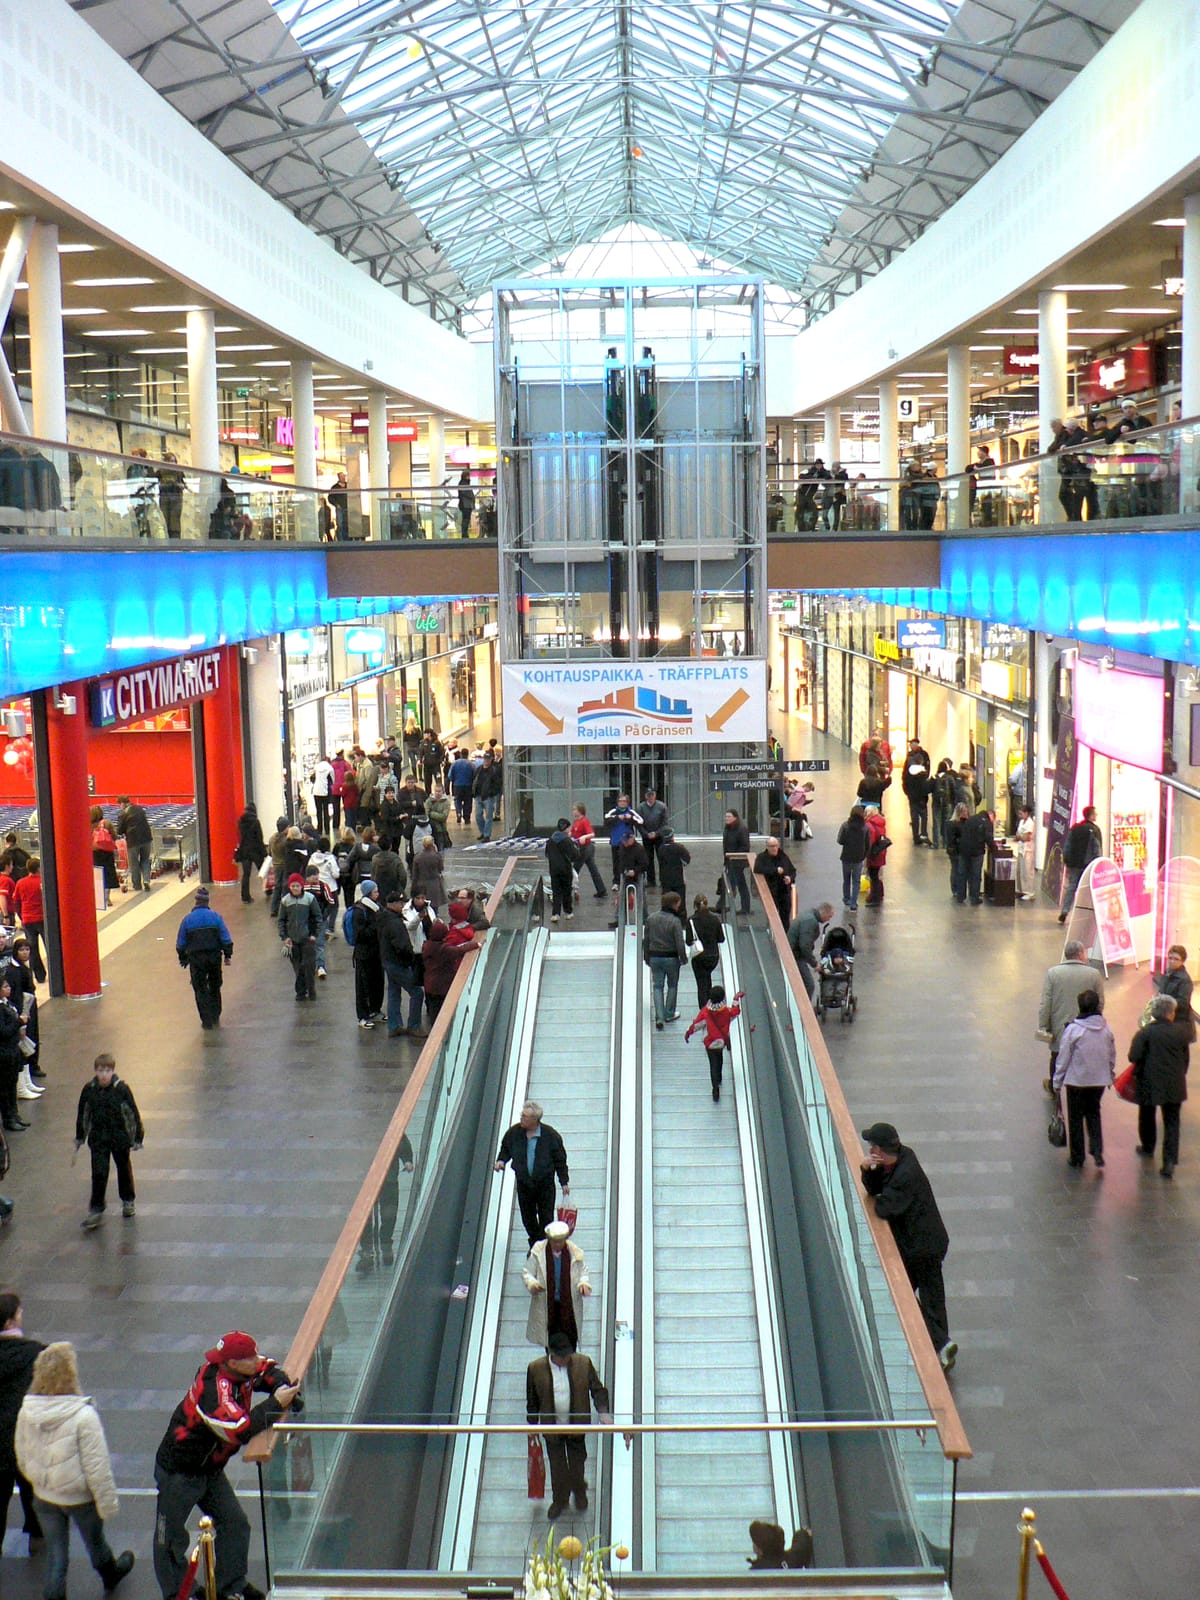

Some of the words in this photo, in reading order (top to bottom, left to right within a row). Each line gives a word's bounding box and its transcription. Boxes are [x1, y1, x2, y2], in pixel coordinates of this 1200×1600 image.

[900, 399, 913, 416] g
[901, 634, 941, 646] SPORT
[523, 668, 644, 684] KOHTAUSPAIKKA
[658, 665, 749, 681] TRÄFFPLATS
[102, 689, 114, 718] K
[116, 652, 221, 720] CITYMARKET
[577, 725, 621, 740] Rajalla
[624, 723, 640, 737] På
[641, 723, 693, 737] Gränsen
[719, 763, 775, 773] PULLONPALAUTUS
[733, 780, 775, 789] PYSÄKÖINTI
